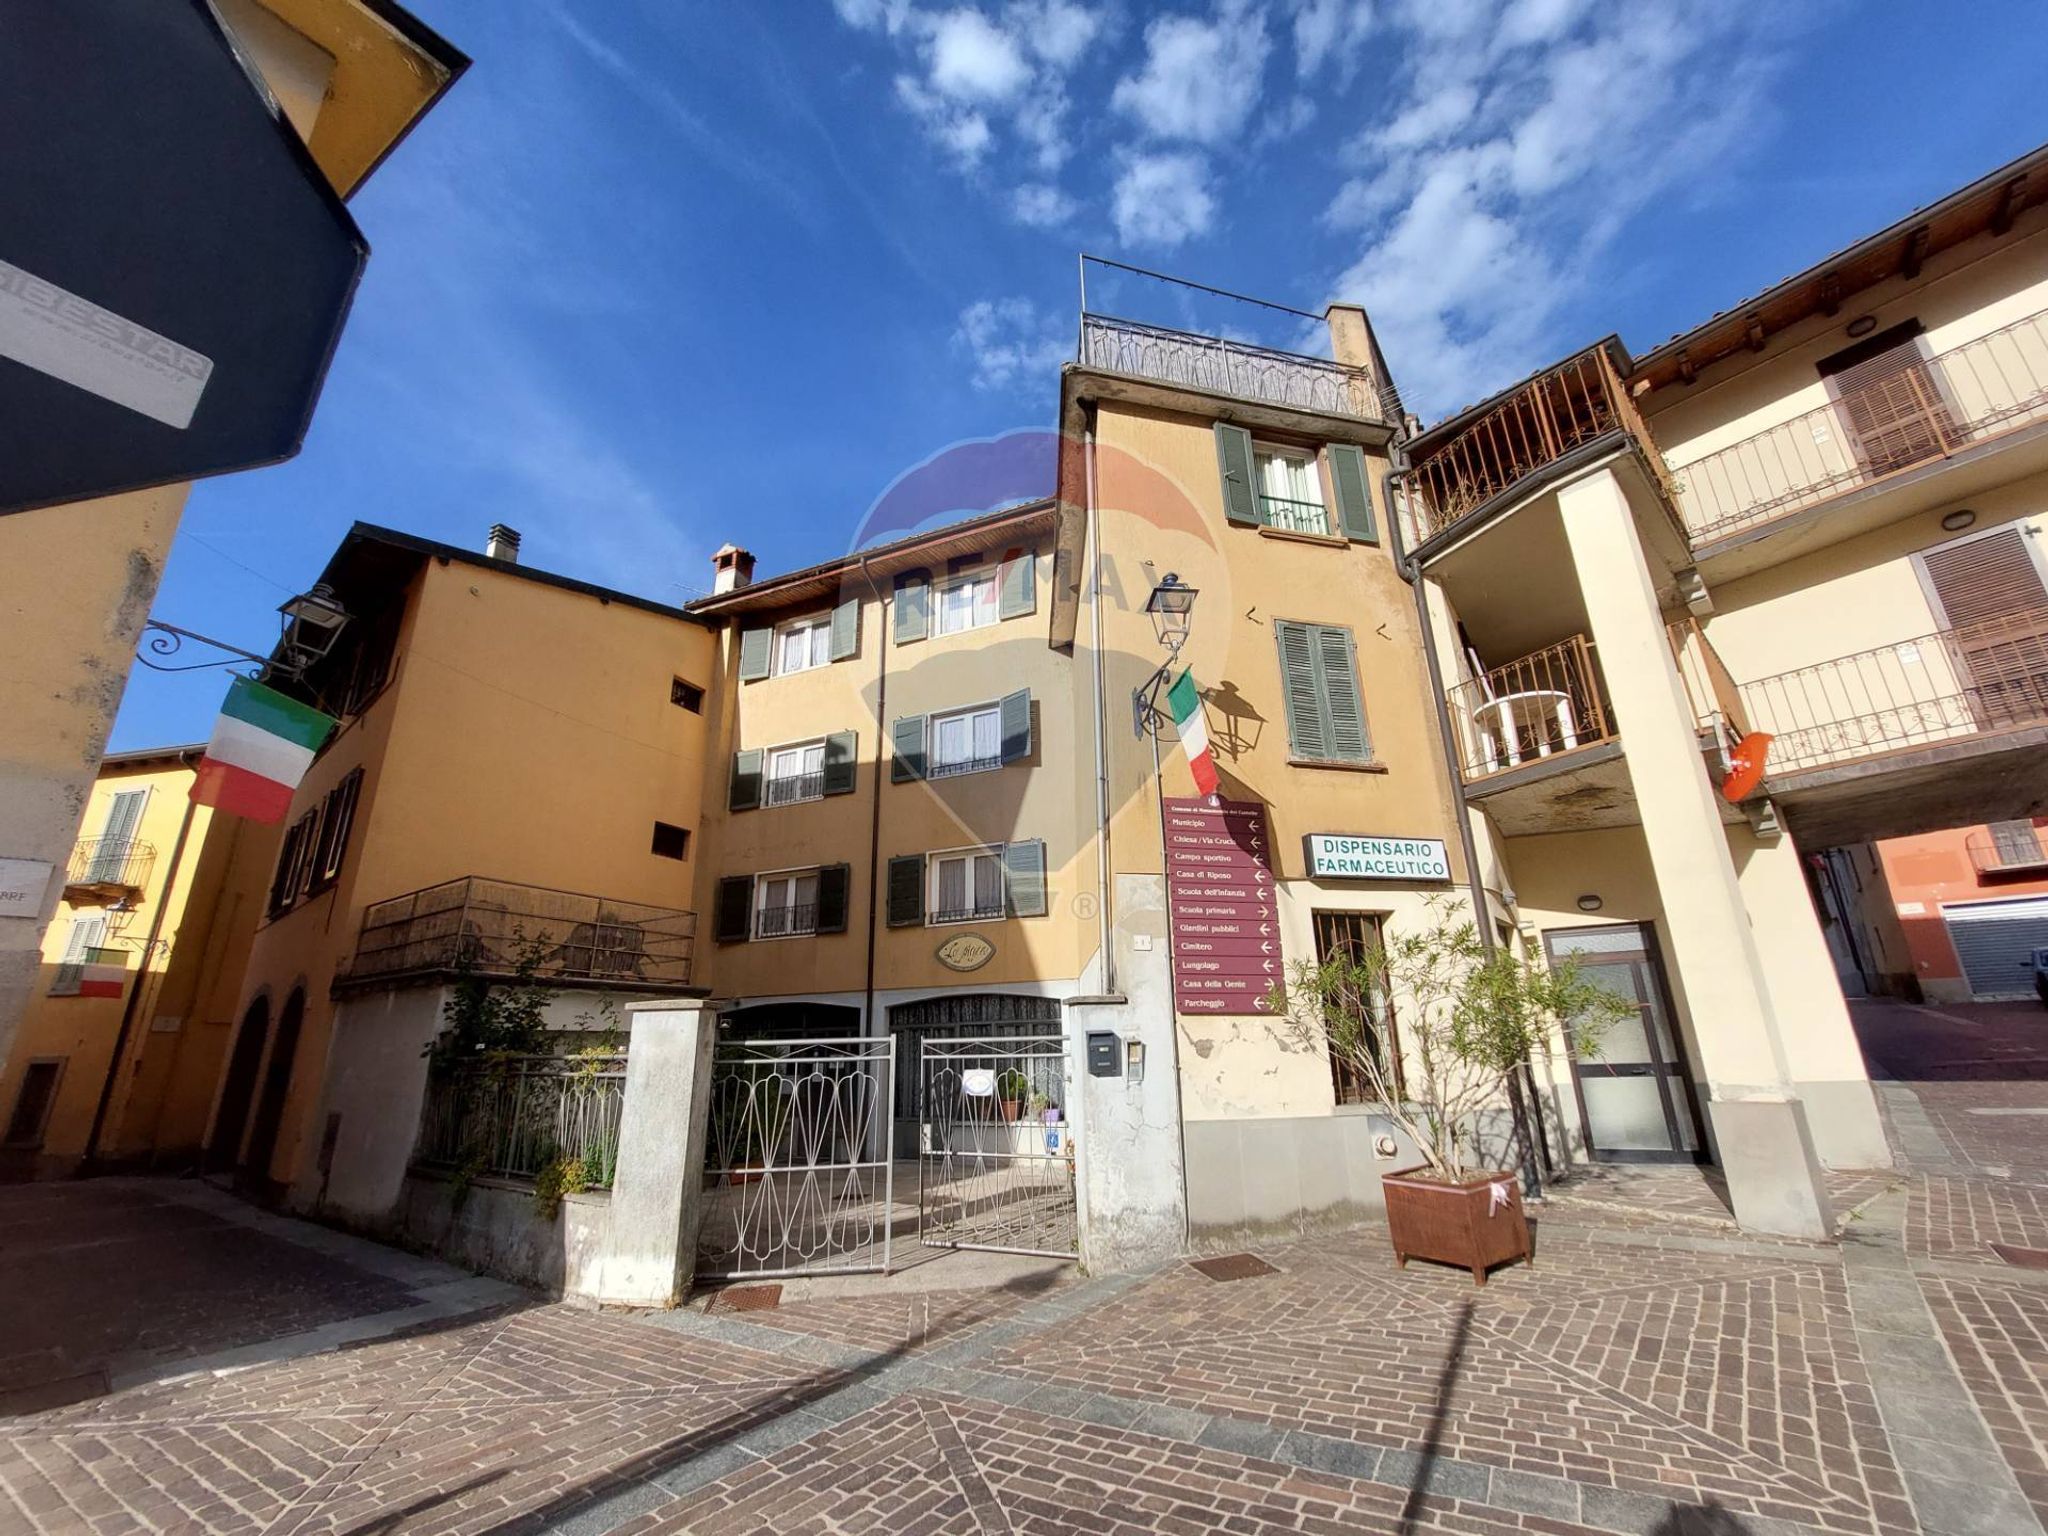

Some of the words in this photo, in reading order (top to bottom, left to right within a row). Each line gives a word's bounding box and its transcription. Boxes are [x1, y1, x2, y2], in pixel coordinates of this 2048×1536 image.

[0, 272, 206, 375] IBESTAR
[1172, 818, 1206, 828] Municipio
[1173, 835, 1198, 844] Chiesa
[1324, 839, 1432, 857] DISPENSARIO
[1175, 852, 1201, 862] Campo
[1203, 853, 1232, 862] sportivo
[1317, 858, 1445, 875] FARMACEUTICO
[1176, 870, 1195, 878] Casa
[1207, 871, 1232, 880] Riposo
[1178, 888, 1202, 896] Scuola
[1179, 906, 1203, 914] Scuola
[1205, 906, 1236, 916] primaria
[1180, 924, 1209, 932] Giardini
[1211, 924, 1240, 933] pubblici
[1181, 942, 1213, 951] Cimitero
[1182, 961, 1220, 971] Lungolago
[1183, 979, 1202, 988] Casa
[1184, 999, 1225, 1009] Parcheggio
